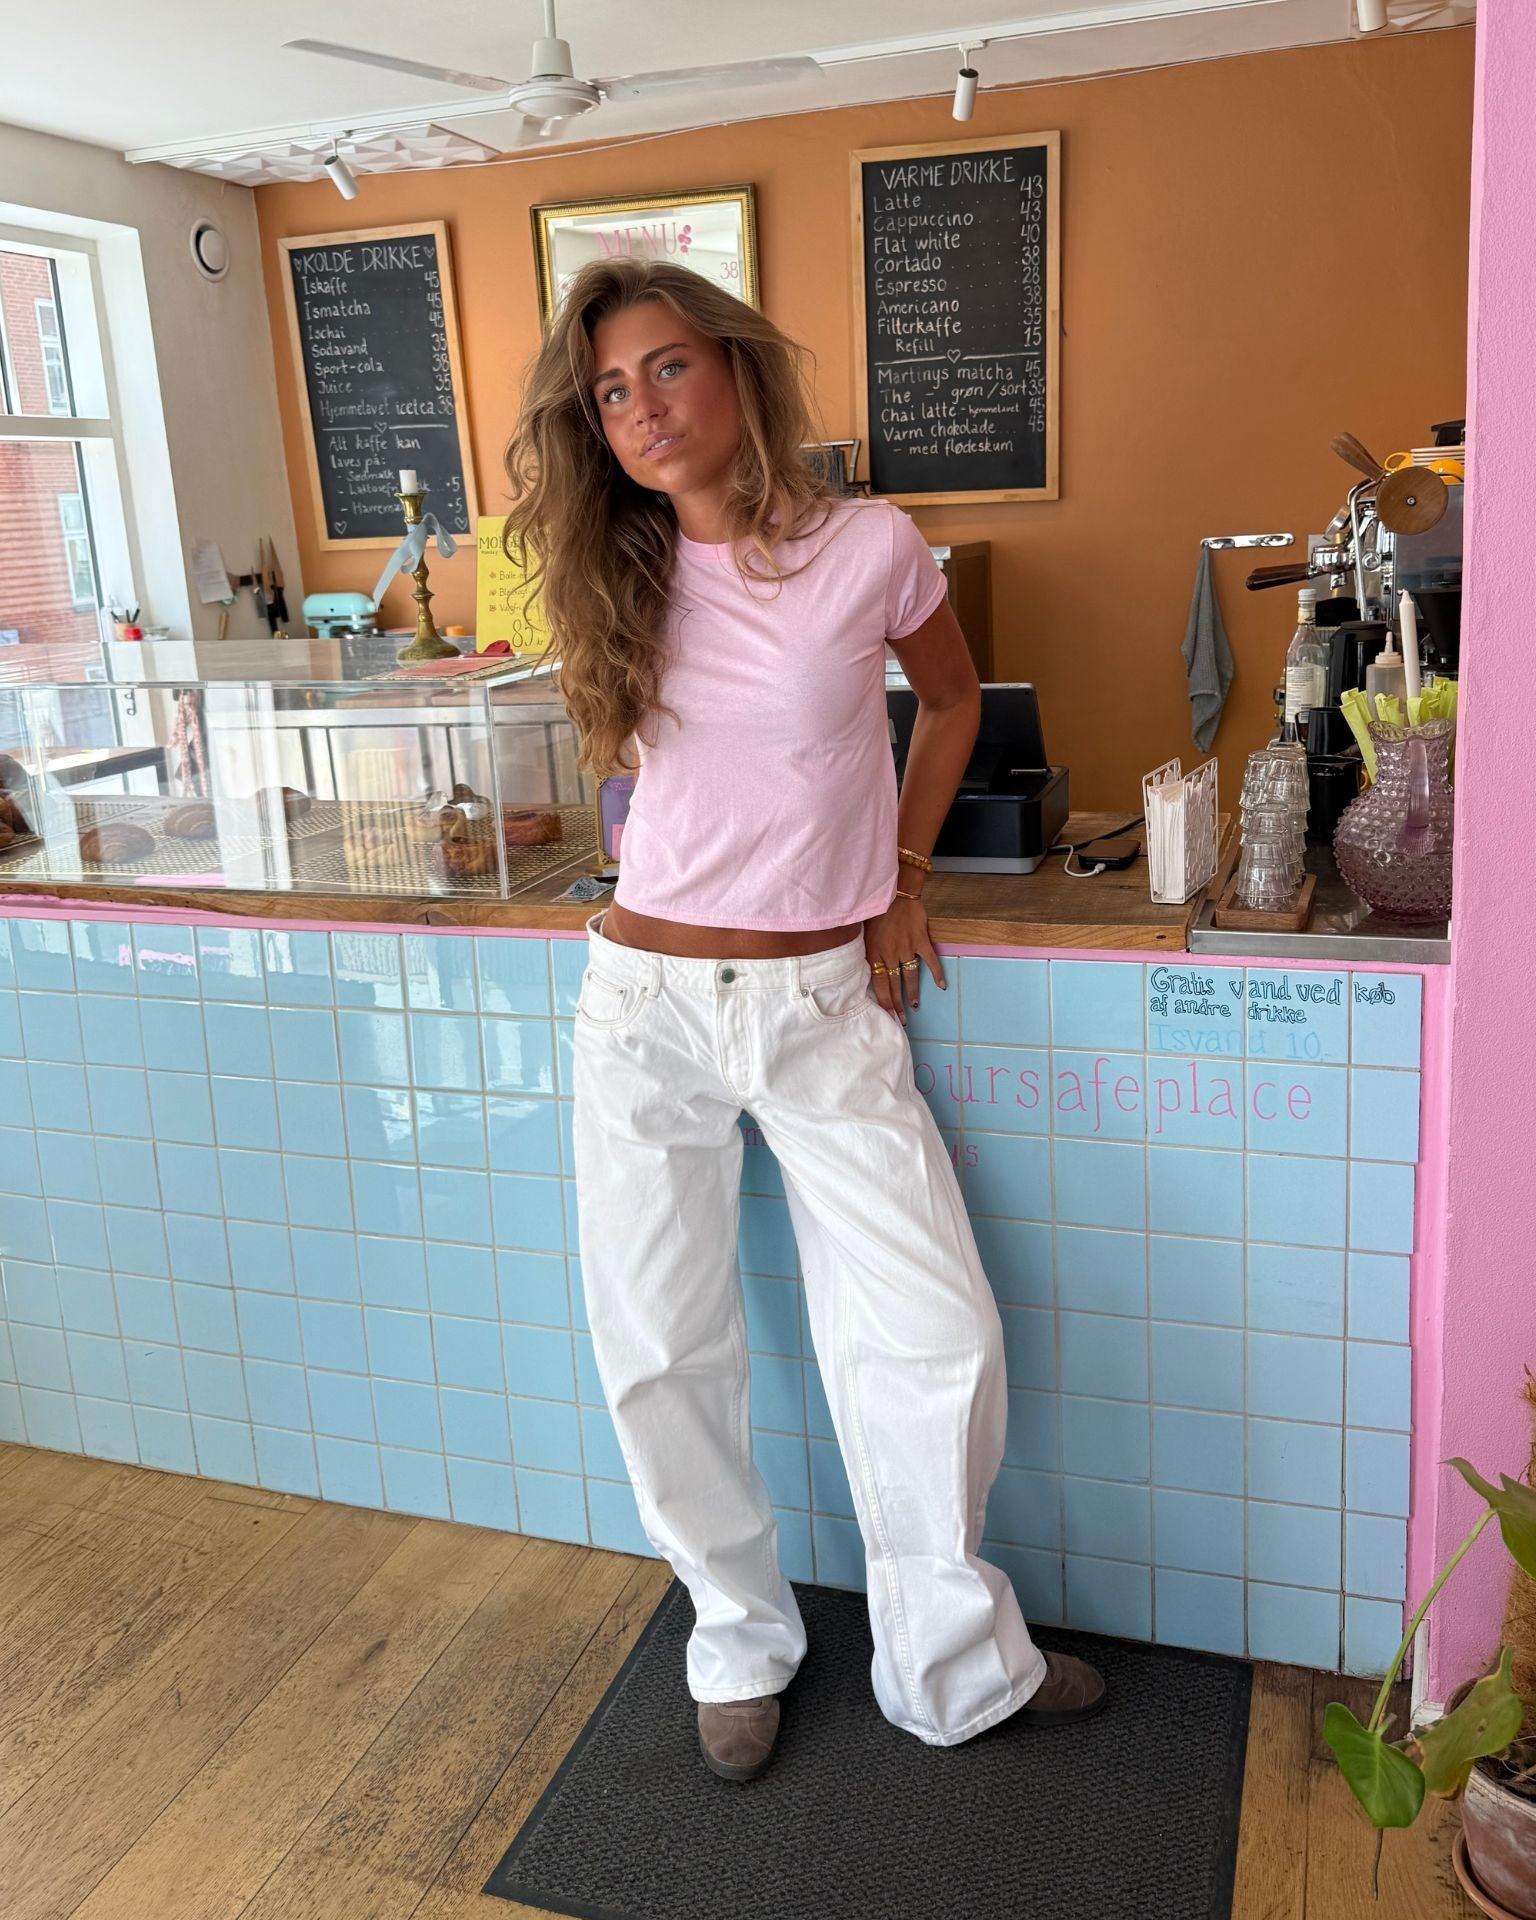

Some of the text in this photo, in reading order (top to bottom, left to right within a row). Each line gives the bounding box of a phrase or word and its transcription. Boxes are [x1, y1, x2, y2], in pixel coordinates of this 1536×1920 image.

[881, 157, 1015, 190] VARME DRIKKE
[873, 175, 1043, 213] Latte 43
[873, 200, 1042, 234] Cappuccino 43
[594, 222, 677, 256] MENU
[874, 223, 1041, 254] Flat white 40
[302, 246, 424, 273] KOLDE DRIKKE
[720, 261, 739, 280] 38
[874, 245, 1041, 274] Cortado 38
[302, 271, 441, 296] Iskaffe 45
[875, 267, 1041, 298] Espresso 28
[304, 292, 443, 320] Ismatcha 45
[877, 286, 1043, 315] Americano 38
[429, 311, 445, 328] 45
[877, 307, 1042, 337] Filterkaffe 35
[312, 333, 447, 358] Sodavand 35
[895, 327, 1042, 355] Refill 15
[314, 354, 450, 378] Sport-cola 38
[877, 359, 1041, 390] Martinys matcha 45
[317, 374, 452, 394] Juice 35
[880, 388, 912, 404] The
[881, 405, 915, 424] Chai
[921, 402, 957, 420] latte
[356, 434, 387, 452] kaffe
[396, 433, 421, 449] kan
[883, 415, 1045, 443] Varm chokolade 45
[331, 454, 361, 469] laves
[909, 441, 938, 456] med
[1150, 966, 1216, 996] Gratis
[1229, 975, 1292, 1002] vand
[1296, 979, 1343, 1006] ved
[1150, 994, 1307, 1024] af andre drikke
[1149, 1023, 1267, 1055] Isvand
